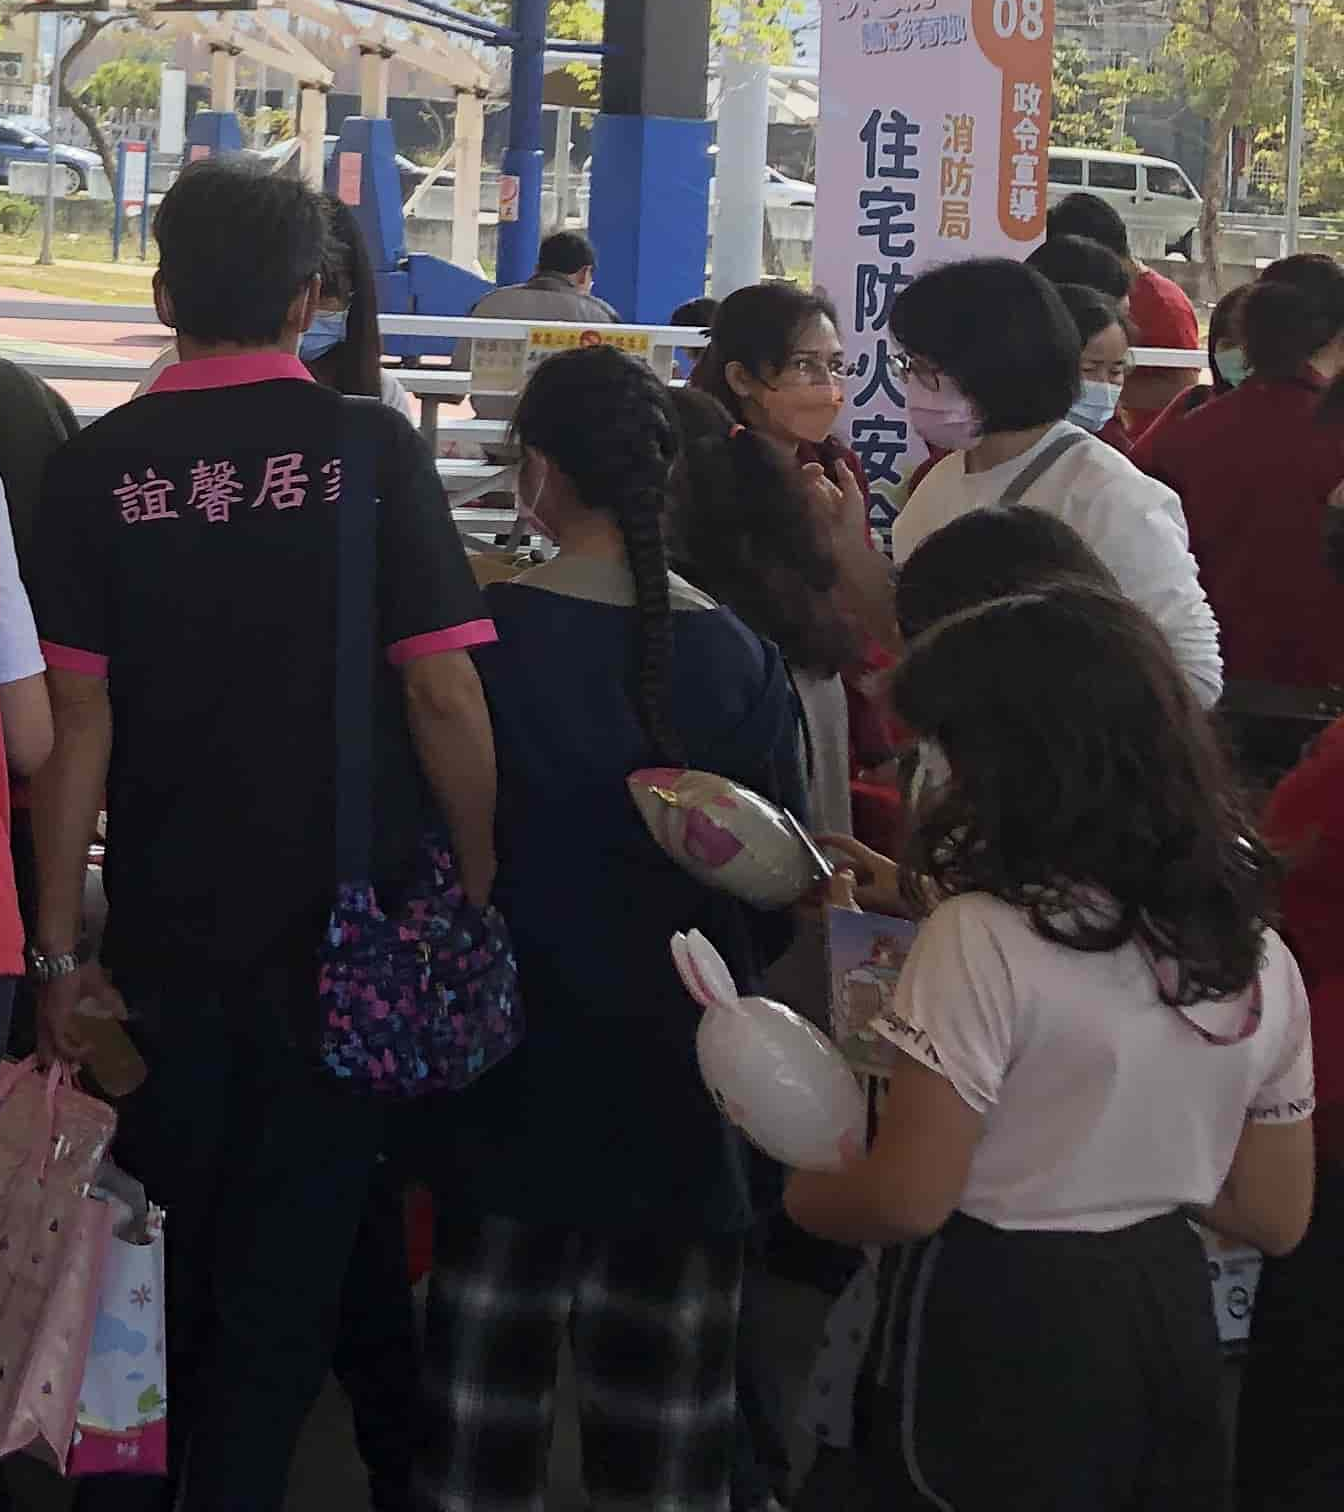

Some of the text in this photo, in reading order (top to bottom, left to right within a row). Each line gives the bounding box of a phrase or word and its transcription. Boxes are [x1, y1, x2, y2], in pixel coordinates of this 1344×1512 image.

[938, 112, 976, 241] 消防局
[1008, 82, 1042, 224] 政令宣導
